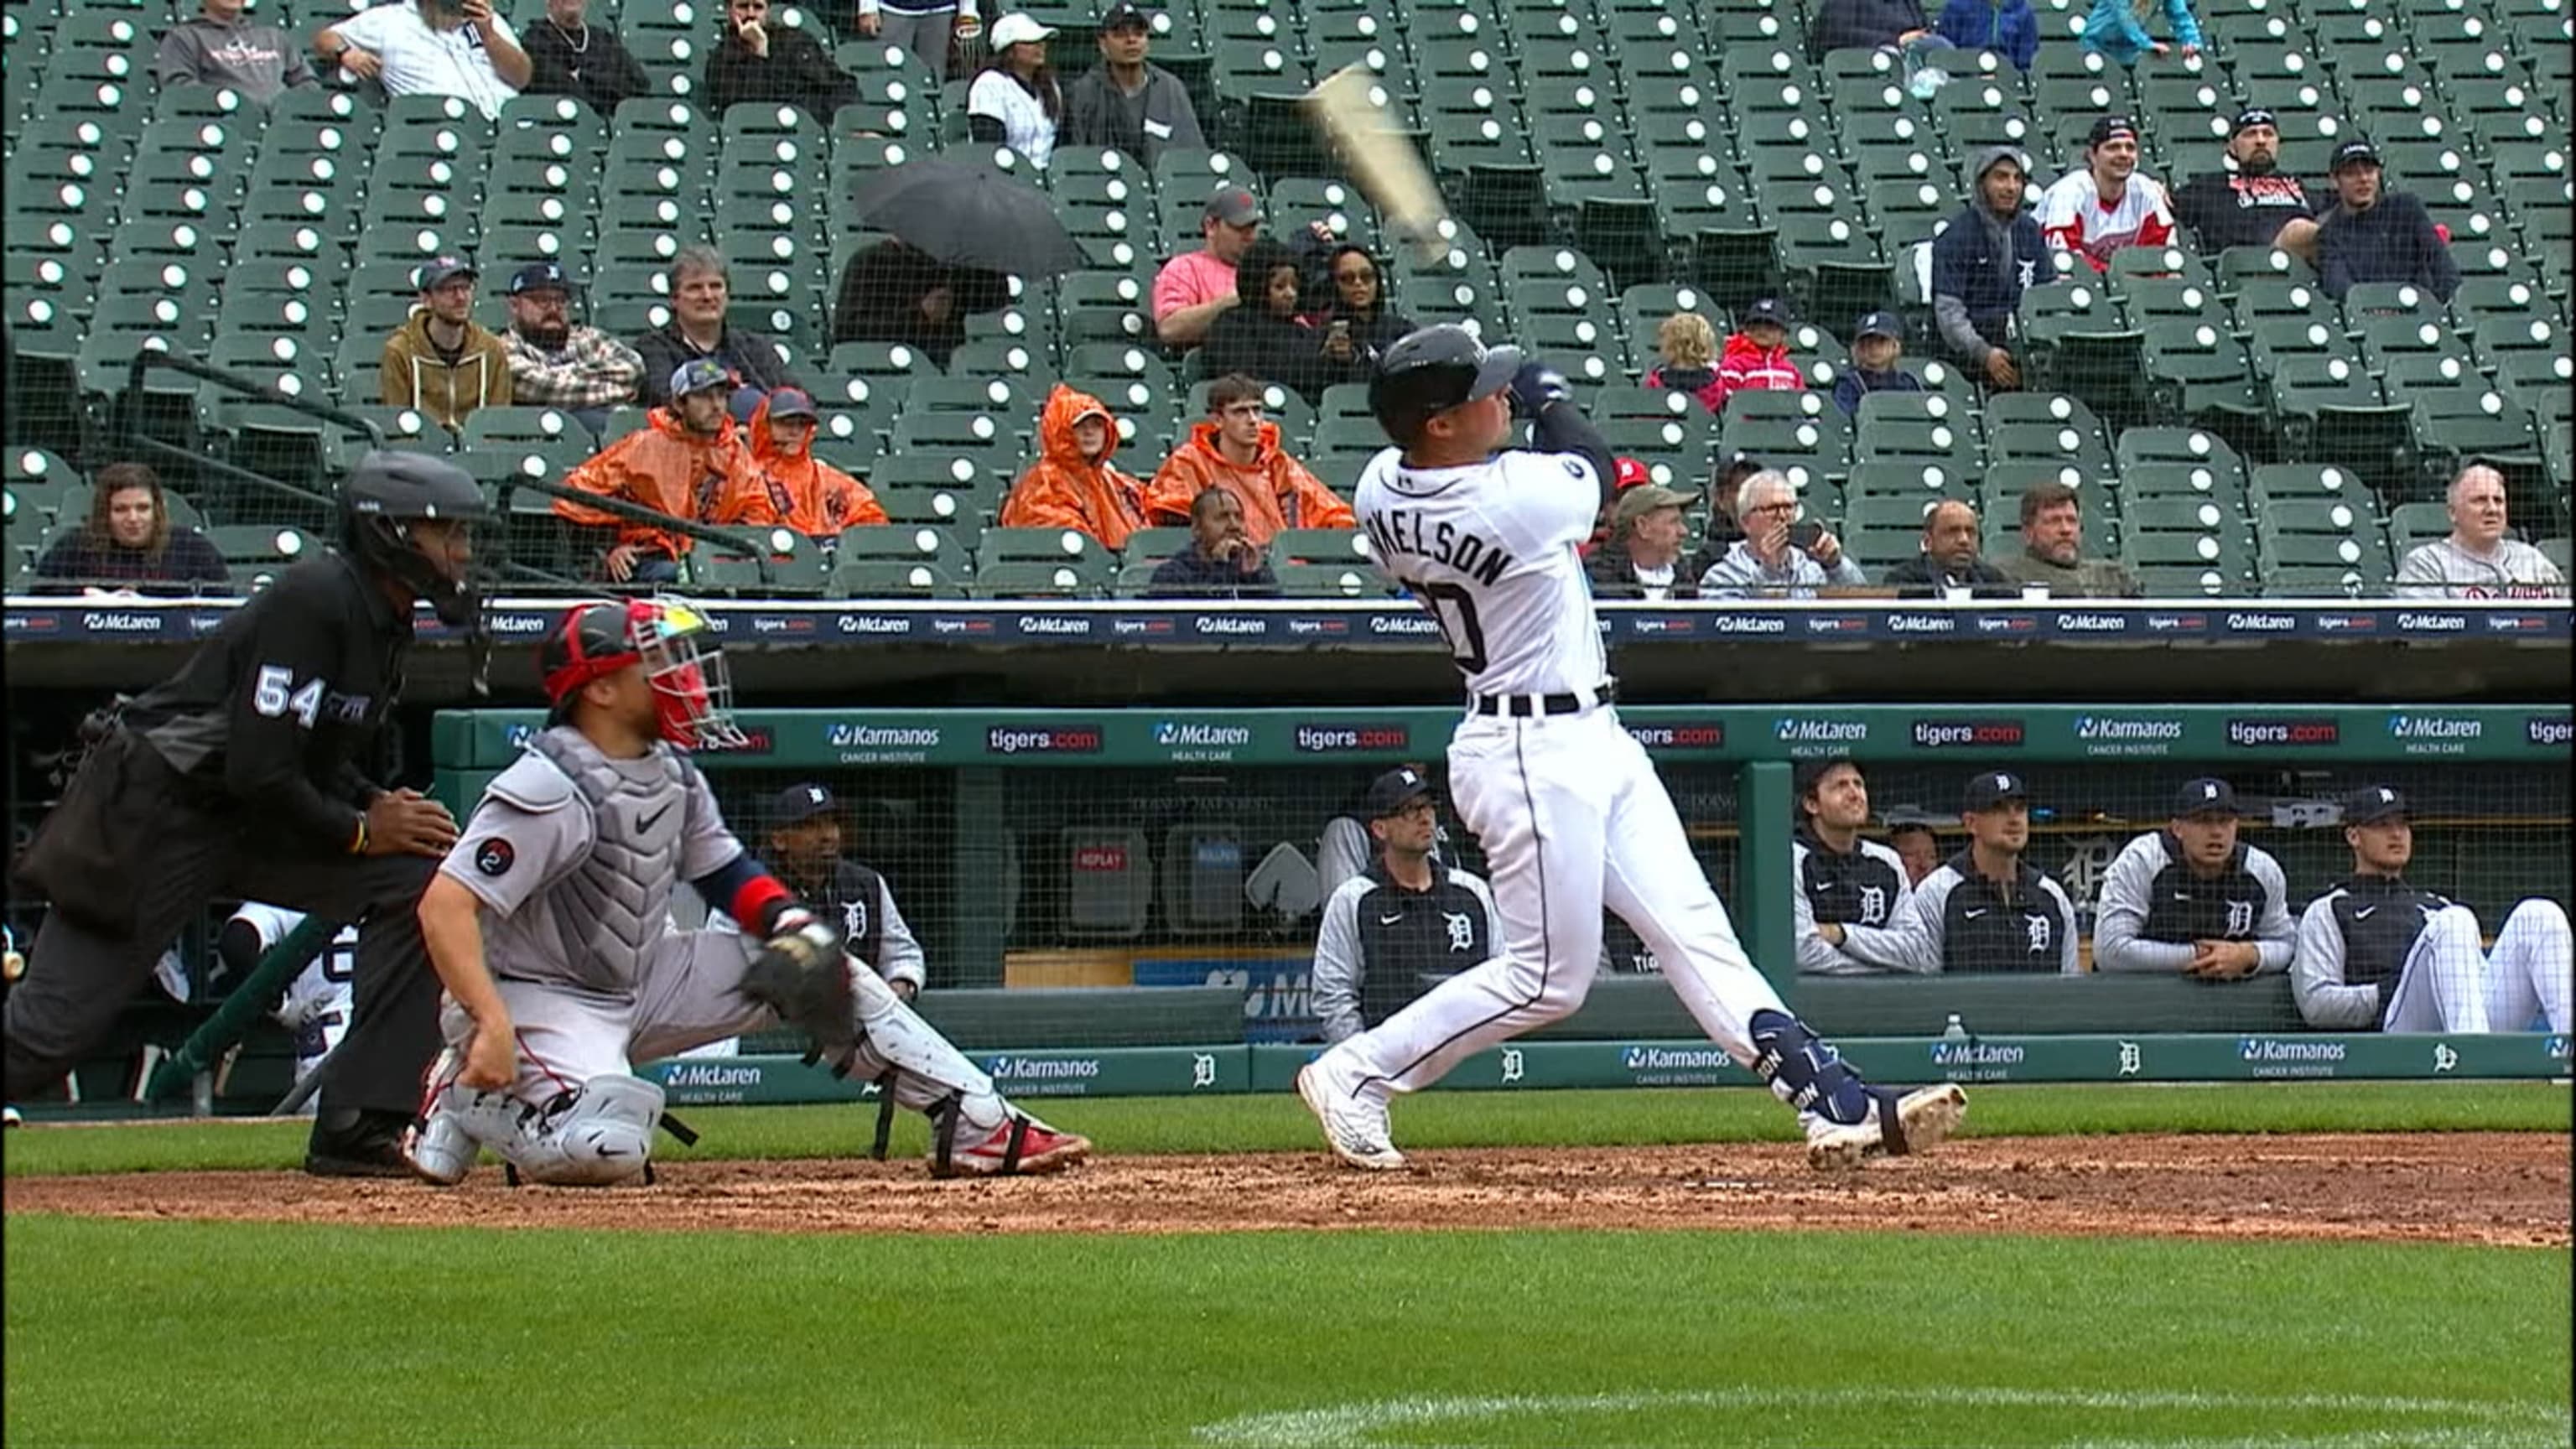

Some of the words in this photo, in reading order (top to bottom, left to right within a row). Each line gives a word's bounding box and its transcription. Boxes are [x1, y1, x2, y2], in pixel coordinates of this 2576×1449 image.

[104, 615, 161, 630] McLaren
[491, 616, 544, 631] McLaren
[858, 617, 910, 632] McLaren
[1038, 618, 1089, 632] McLaren
[1215, 618, 1265, 633] McLaren
[1389, 618, 1440, 633] McLaren
[1734, 618, 1784, 631] McLaren
[1907, 616, 1955, 631] McLaren
[2075, 615, 2125, 630] McLaren
[2245, 615, 2295, 630] McLaren
[2416, 615, 2465, 629] McLaren
[254, 664, 325, 728] 54
[853, 726, 940, 745] Karmanos
[1179, 725, 1249, 745] McLaren
[1799, 721, 1867, 739] McLaren
[1915, 723, 2022, 745] tigers.com
[2099, 719, 2182, 738] Karmanos
[2231, 722, 2336, 744] tigers.com
[2414, 719, 2482, 737] McLaren
[2530, 721, 2572, 743] tiger
[990, 729, 1098, 751] tigers.com
[1299, 728, 1405, 750] tigers.com
[1172, 751, 1206, 761] HEALTH
[1208, 751, 1232, 761] CARE
[1791, 746, 1824, 756] HEALTH
[1826, 746, 1851, 756] CARE
[2088, 745, 2122, 754] CANCER
[2407, 744, 2440, 753] HEALTH
[2443, 744, 2465, 753] CARE
[841, 753, 877, 762] CANCER
[480, 849, 501, 872] 2
[1648, 1048, 1730, 1068] Karmanos
[1954, 1045, 2024, 1064] McLaren
[2263, 1041, 2345, 1061] Karmanos
[688, 1066, 761, 1085] McLaren
[1013, 1058, 1099, 1078] Karmanos
[1946, 1070, 1982, 1080] HEALTH
[1984, 1069, 2007, 1079] CARE
[2253, 1067, 2288, 1077] CANCER
[1637, 1074, 1671, 1084] CANCER
[679, 1092, 715, 1102] HEALTH
[718, 1091, 744, 1101] CARE
[1002, 1084, 1039, 1094] CANCER
